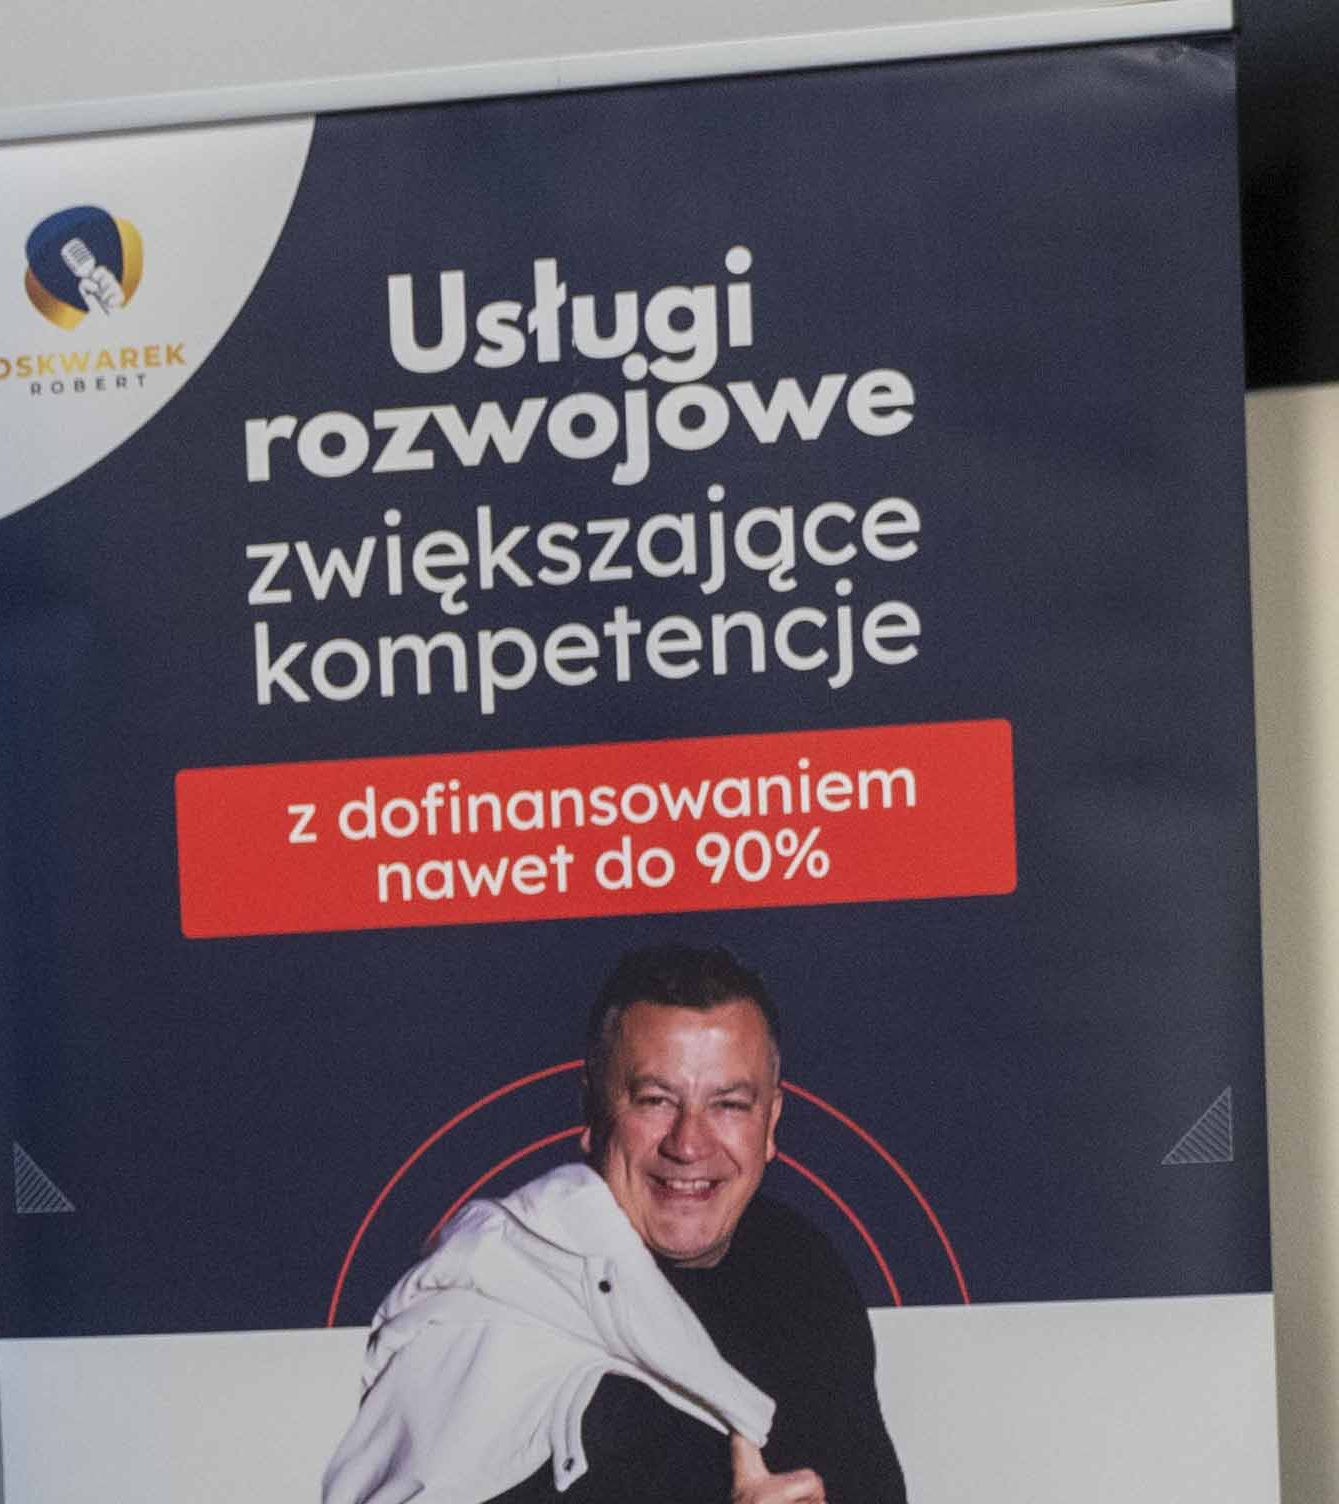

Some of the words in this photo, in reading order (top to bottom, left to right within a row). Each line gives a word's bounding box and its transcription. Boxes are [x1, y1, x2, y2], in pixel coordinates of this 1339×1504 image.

[387, 246, 753, 383] Usługi
[30, 374, 147, 395] ROBERT
[244, 355, 915, 485] rozwojowe
[245, 486, 921, 614] zwiększające
[253, 578, 921, 714] kompetencje
[287, 803, 318, 843] z
[338, 758, 916, 840] dofinansowaniem
[377, 842, 575, 902] nawet
[594, 835, 676, 891] do
[695, 826, 831, 884] 90%
